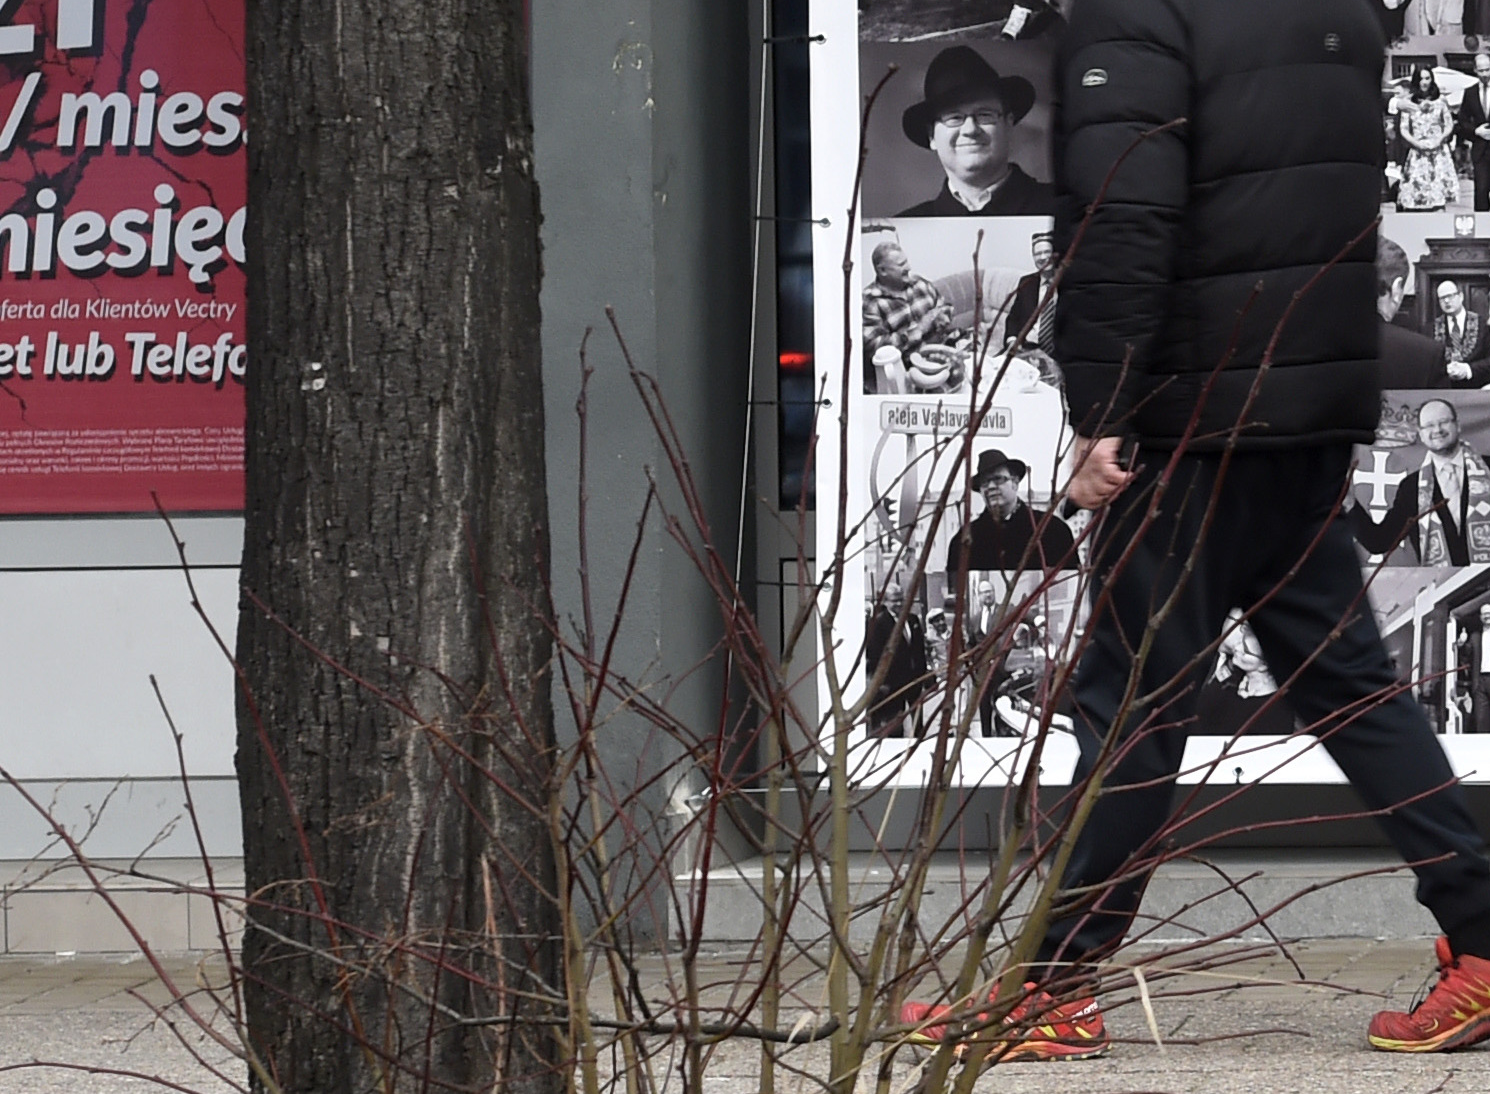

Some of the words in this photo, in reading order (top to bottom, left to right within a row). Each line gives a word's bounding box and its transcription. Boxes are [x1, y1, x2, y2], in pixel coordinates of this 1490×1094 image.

[50, 298, 80, 319] dla
[85, 297, 170, 319] Klientów
[174, 297, 236, 322] Vectry
[43, 330, 115, 376] lub
